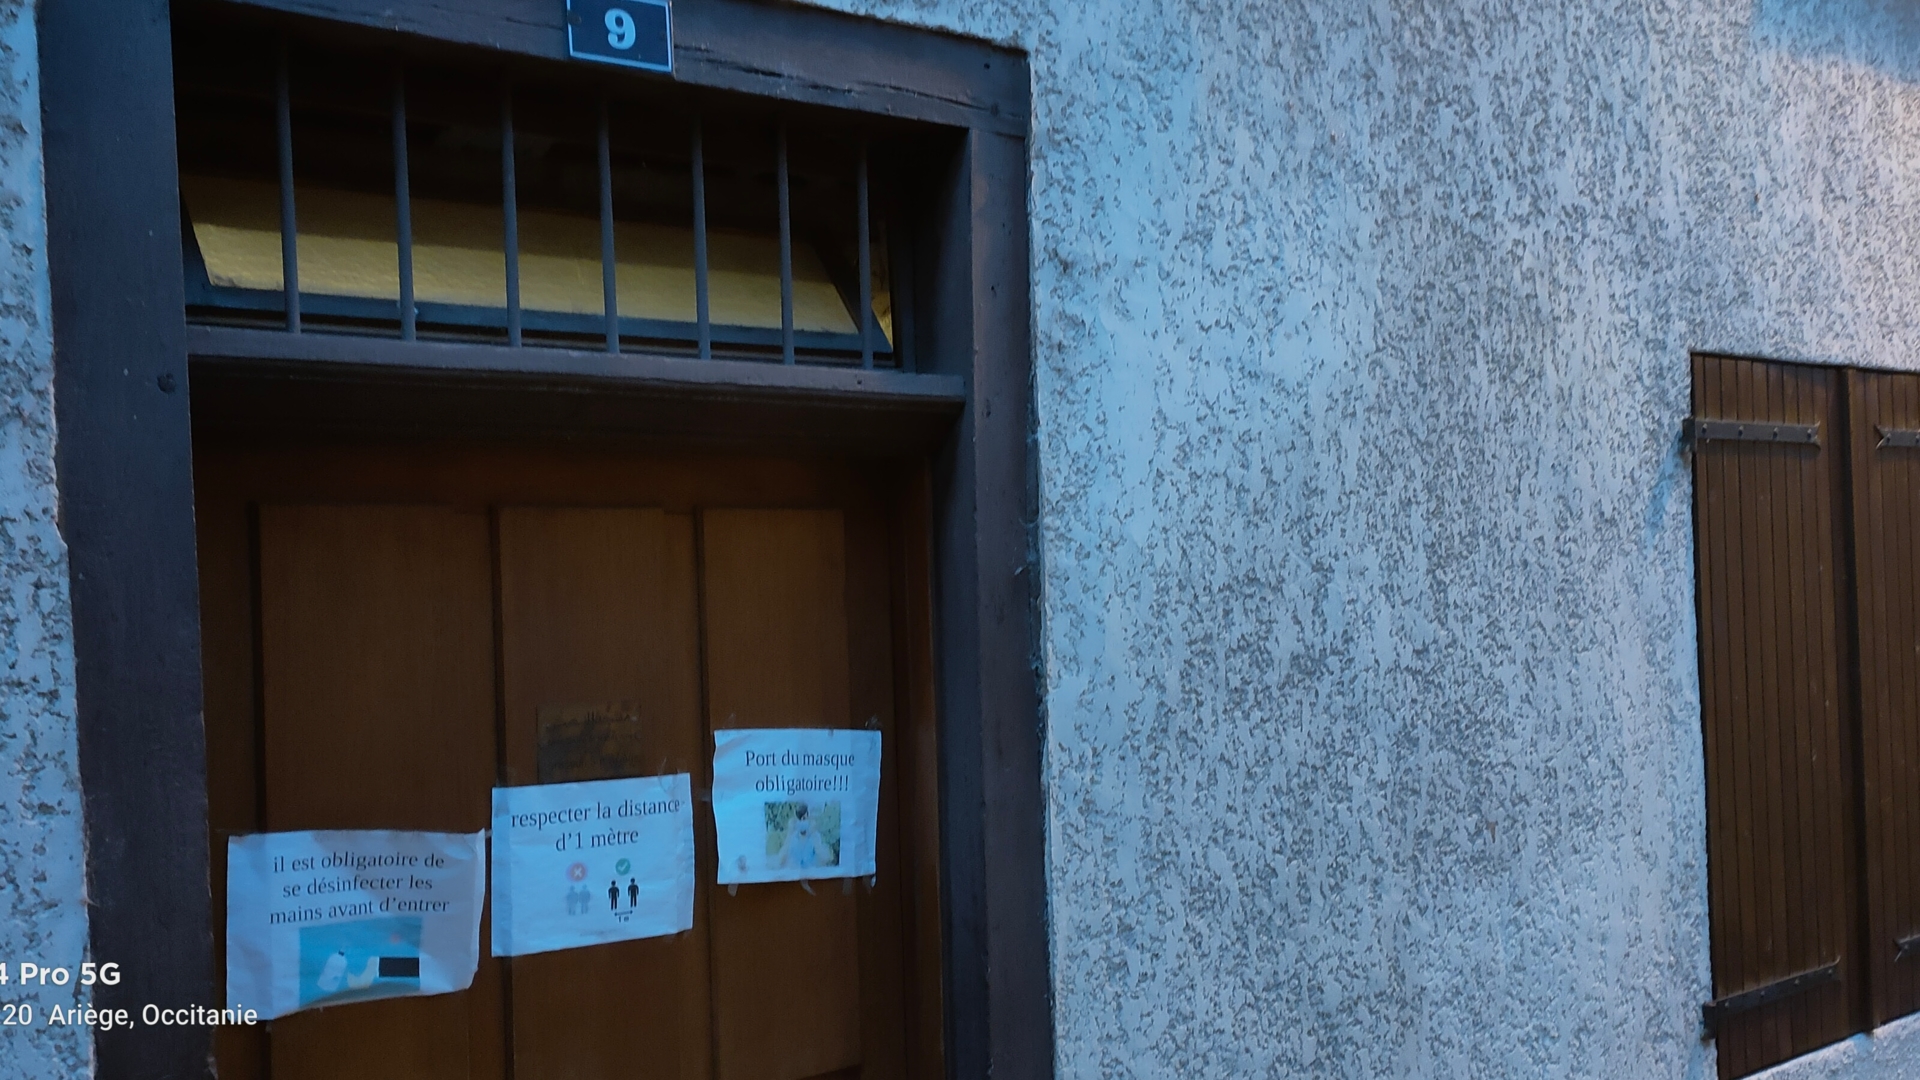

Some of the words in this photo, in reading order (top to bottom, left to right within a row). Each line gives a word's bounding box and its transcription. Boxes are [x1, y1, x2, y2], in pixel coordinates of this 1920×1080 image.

[604, 7, 636, 50] 9
[745, 750, 777, 767] Port
[781, 749, 799, 767] du
[802, 752, 855, 770] masque
[755, 775, 850, 795] obligatoire!!!
[511, 806, 591, 830] respecter
[597, 802, 611, 820] la
[618, 799, 680, 817] distance
[591, 828, 639, 848] mètre
[274, 856, 285, 873] il
[292, 857, 315, 871] est
[321, 851, 419, 870] obligatoire
[424, 853, 445, 869] de
[283, 883, 301, 897] se
[307, 875, 403, 895] désinfecter
[409, 875, 433, 890] les
[270, 907, 323, 924] mains
[328, 903, 374, 918] avant
[379, 897, 450, 912] d’entrer
